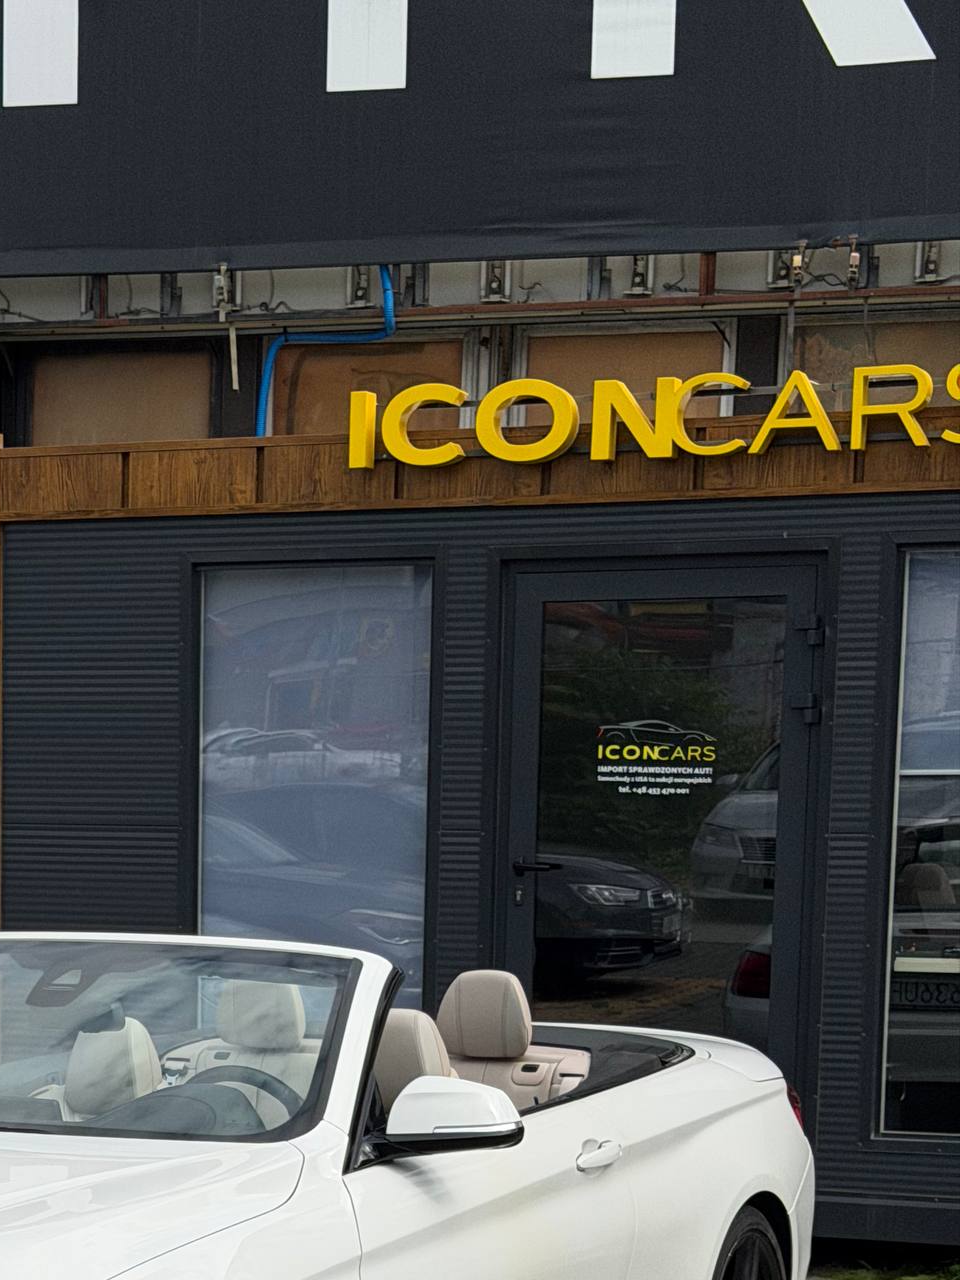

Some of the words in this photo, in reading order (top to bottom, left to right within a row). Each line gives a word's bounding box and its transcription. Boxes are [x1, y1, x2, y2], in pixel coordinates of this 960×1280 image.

[597, 744, 716, 761] ICONCARS
[597, 765, 628, 774] IMPORT
[628, 766, 693, 775] SPRAWDZONYCH
[693, 767, 713, 775] AUT!
[618, 785, 632, 794] tel.
